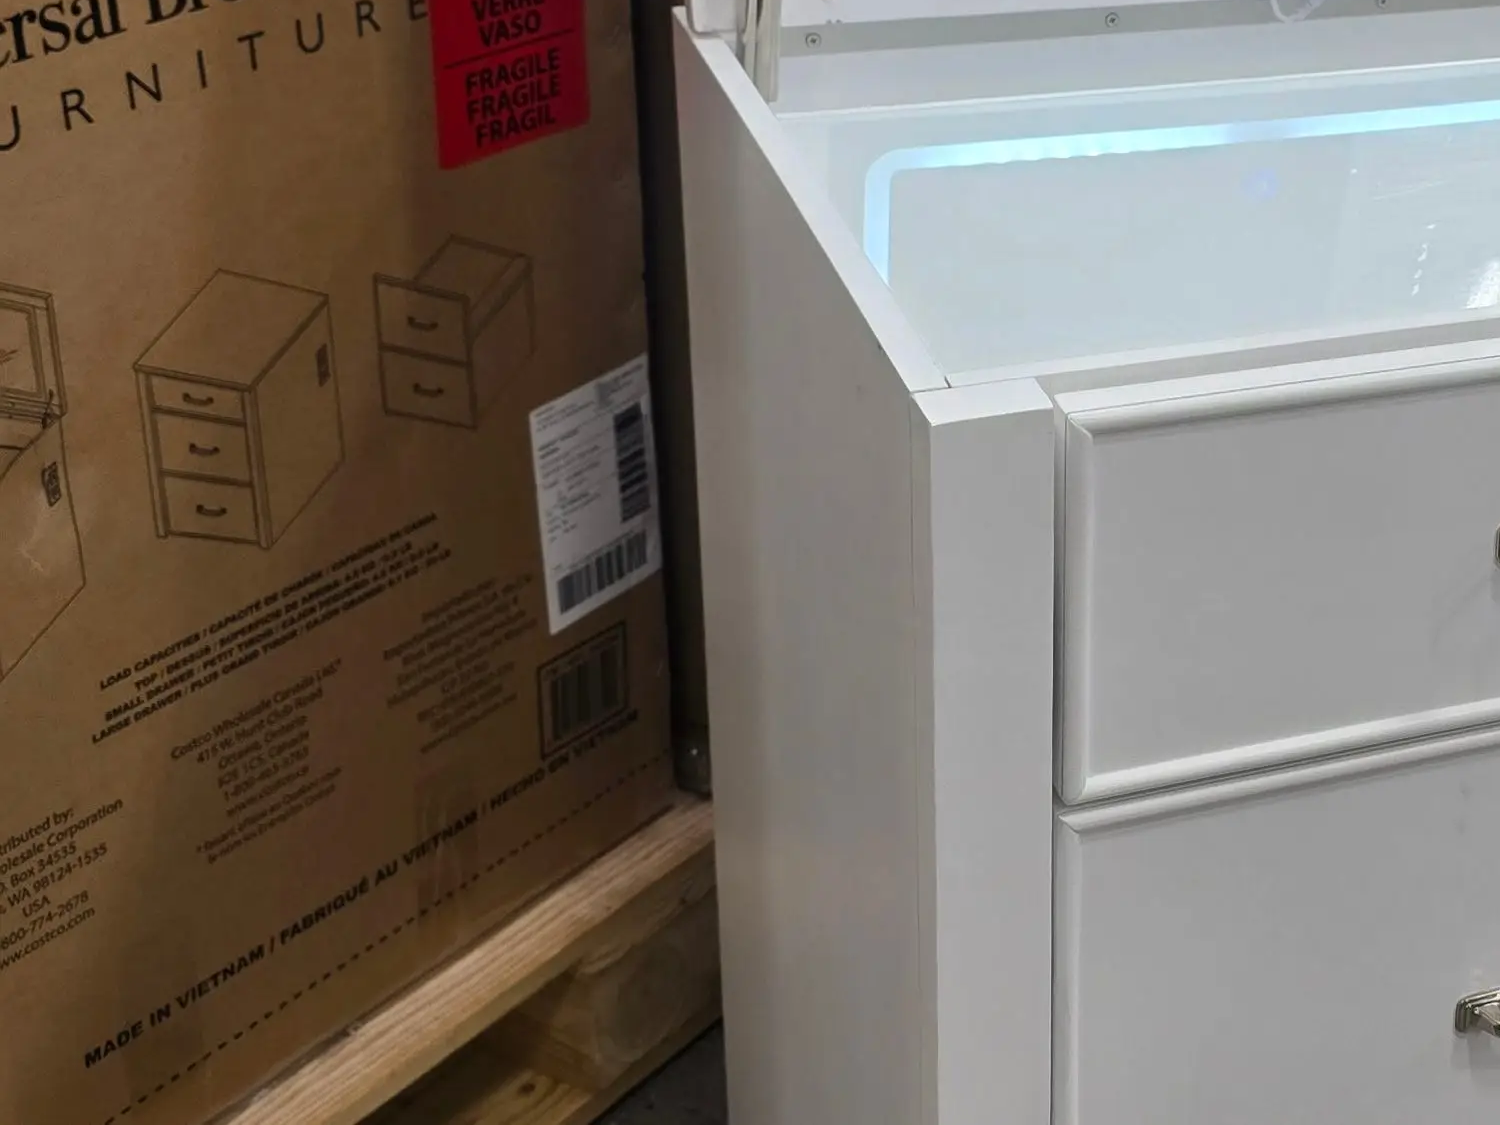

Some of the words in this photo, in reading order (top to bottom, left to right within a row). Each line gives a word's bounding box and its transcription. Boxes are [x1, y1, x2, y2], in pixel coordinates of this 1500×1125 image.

[478, 9, 542, 48] VASO
[465, 47, 562, 98] FRAGILE
[466, 74, 562, 124] FRAGILE
[474, 104, 556, 148] FRAGIL
[100, 667, 132, 691] LOAD
[46, 798, 124, 848] Corporation
[52, 807, 75, 827] by:
[7, 886, 32, 907] WA
[32, 841, 108, 895] 98124-1535
[10, 867, 36, 889] Box
[37, 841, 77, 873] 34535
[23, 894, 51, 918] USA
[84, 1020, 144, 1069] MADE
[150, 1003, 172, 1028] IN
[175, 943, 266, 1010] VIETNAM
[280, 875, 369, 946] FABRIQUÉ
[375, 859, 400, 888] AU
[402, 810, 478, 866] VIETNAM
[490, 767, 547, 812] HECHO
